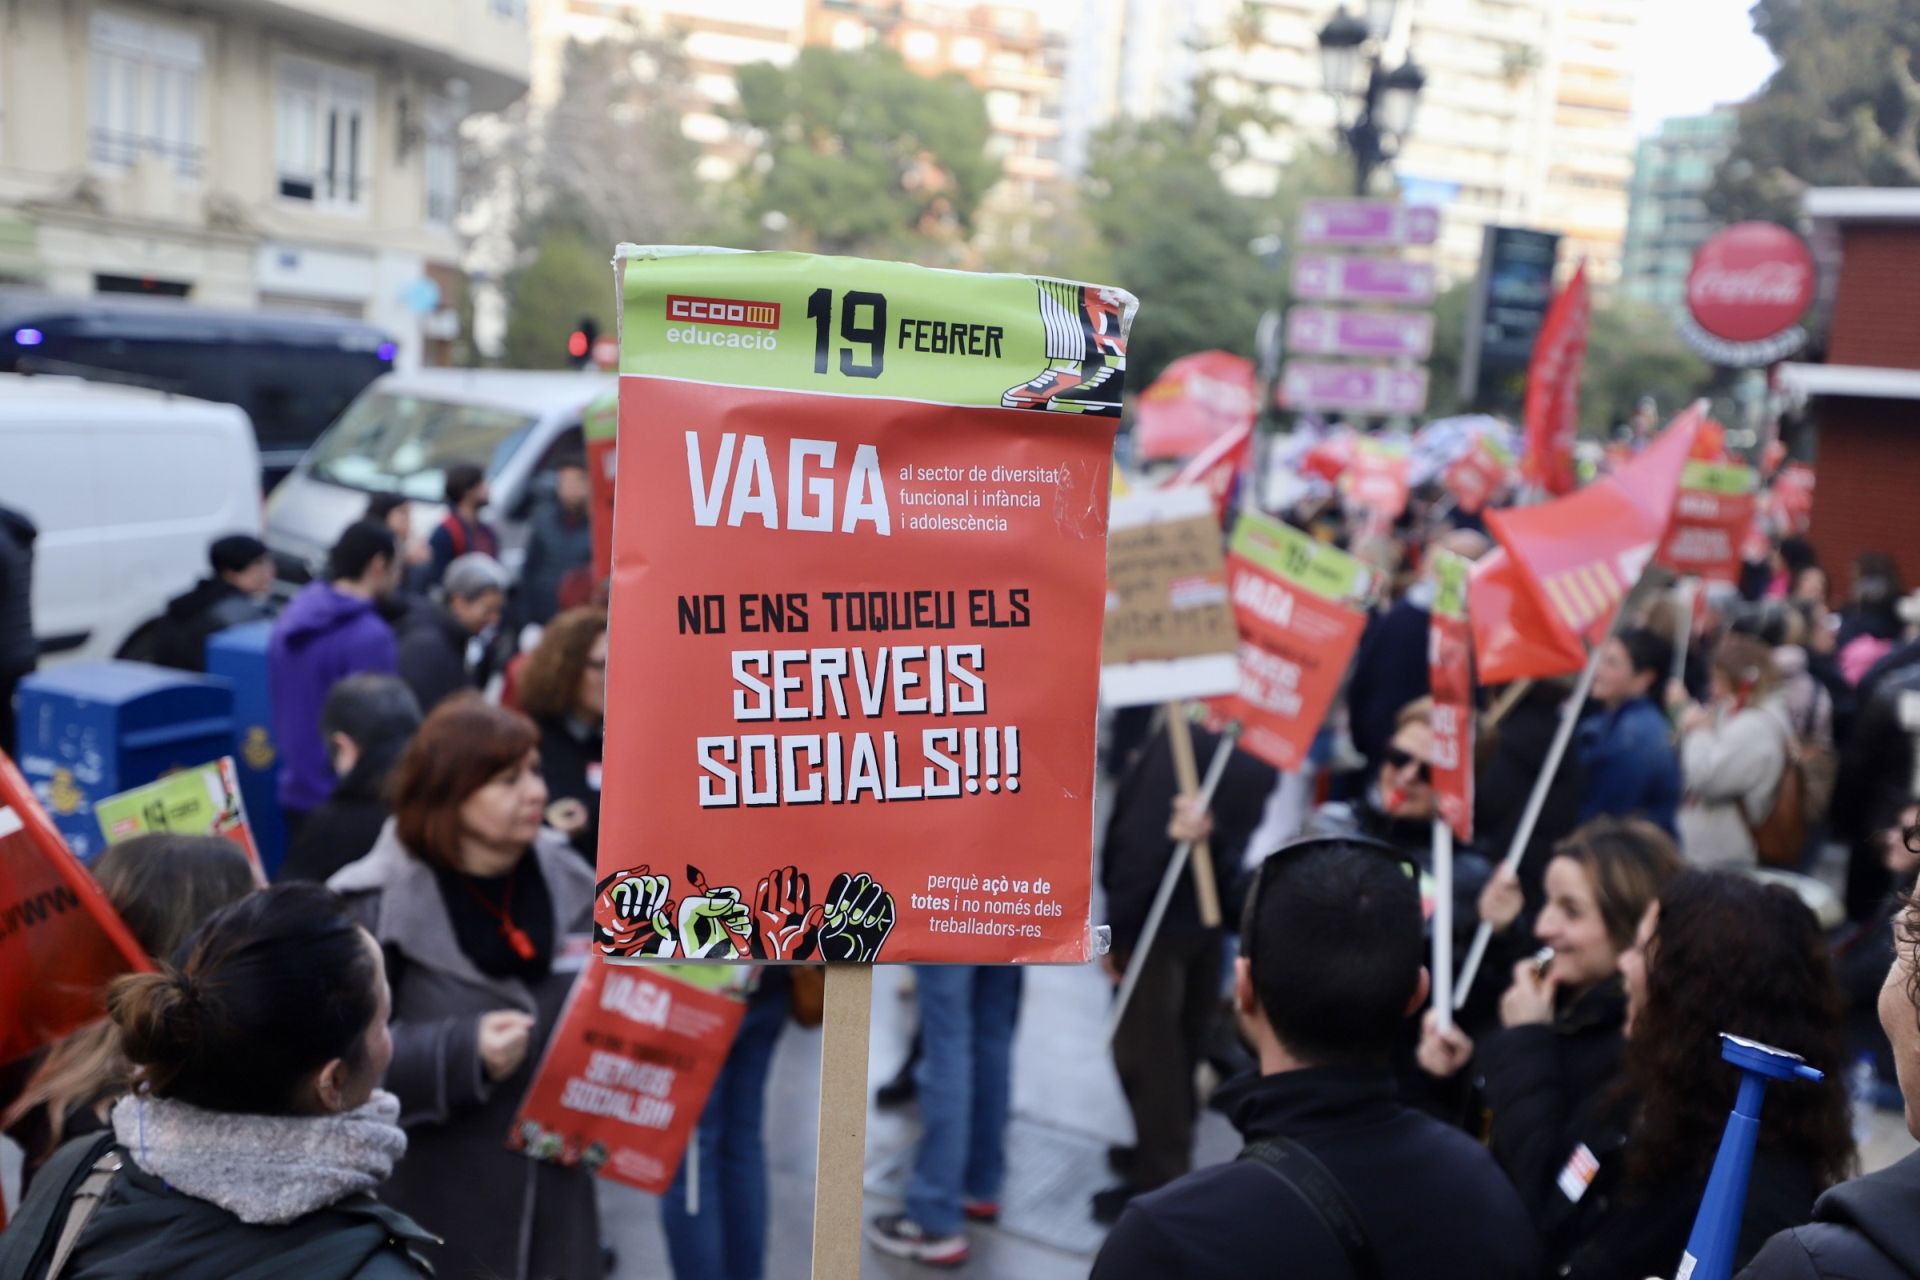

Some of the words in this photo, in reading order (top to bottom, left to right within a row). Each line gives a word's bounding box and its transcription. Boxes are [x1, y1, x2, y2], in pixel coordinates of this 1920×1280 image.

[672, 300, 744, 322] CCOO
[666, 326, 777, 351] educació
[807, 288, 887, 378] 19
[899, 319, 1003, 358] FEBRER
[685, 431, 891, 536] VAGA
[899, 464, 913, 481] al
[917, 466, 964, 482] sector
[969, 465, 987, 482] de
[991, 465, 1059, 484] diversitat
[899, 488, 969, 506] funcional
[973, 490, 977, 506] i
[982, 490, 1041, 507] infància
[901, 513, 905, 529] i
[910, 513, 1008, 531] adolescència
[678, 594, 725, 634] NO
[740, 593, 809, 633] ENS
[822, 591, 955, 632] TOQUEU
[969, 588, 1030, 628] ELS
[731, 644, 987, 721] SERVEIS
[697, 725, 1021, 808] SOCIALS!!!
[927, 874, 979, 892] perquè
[982, 875, 1009, 895] açò
[1012, 880, 1029, 894] va
[1033, 878, 1051, 894] de
[911, 893, 950, 911] totes
[962, 899, 980, 913] no
[984, 898, 1031, 916] només
[1034, 900, 1062, 917] dels
[929, 916, 1041, 938] treballadors-res
